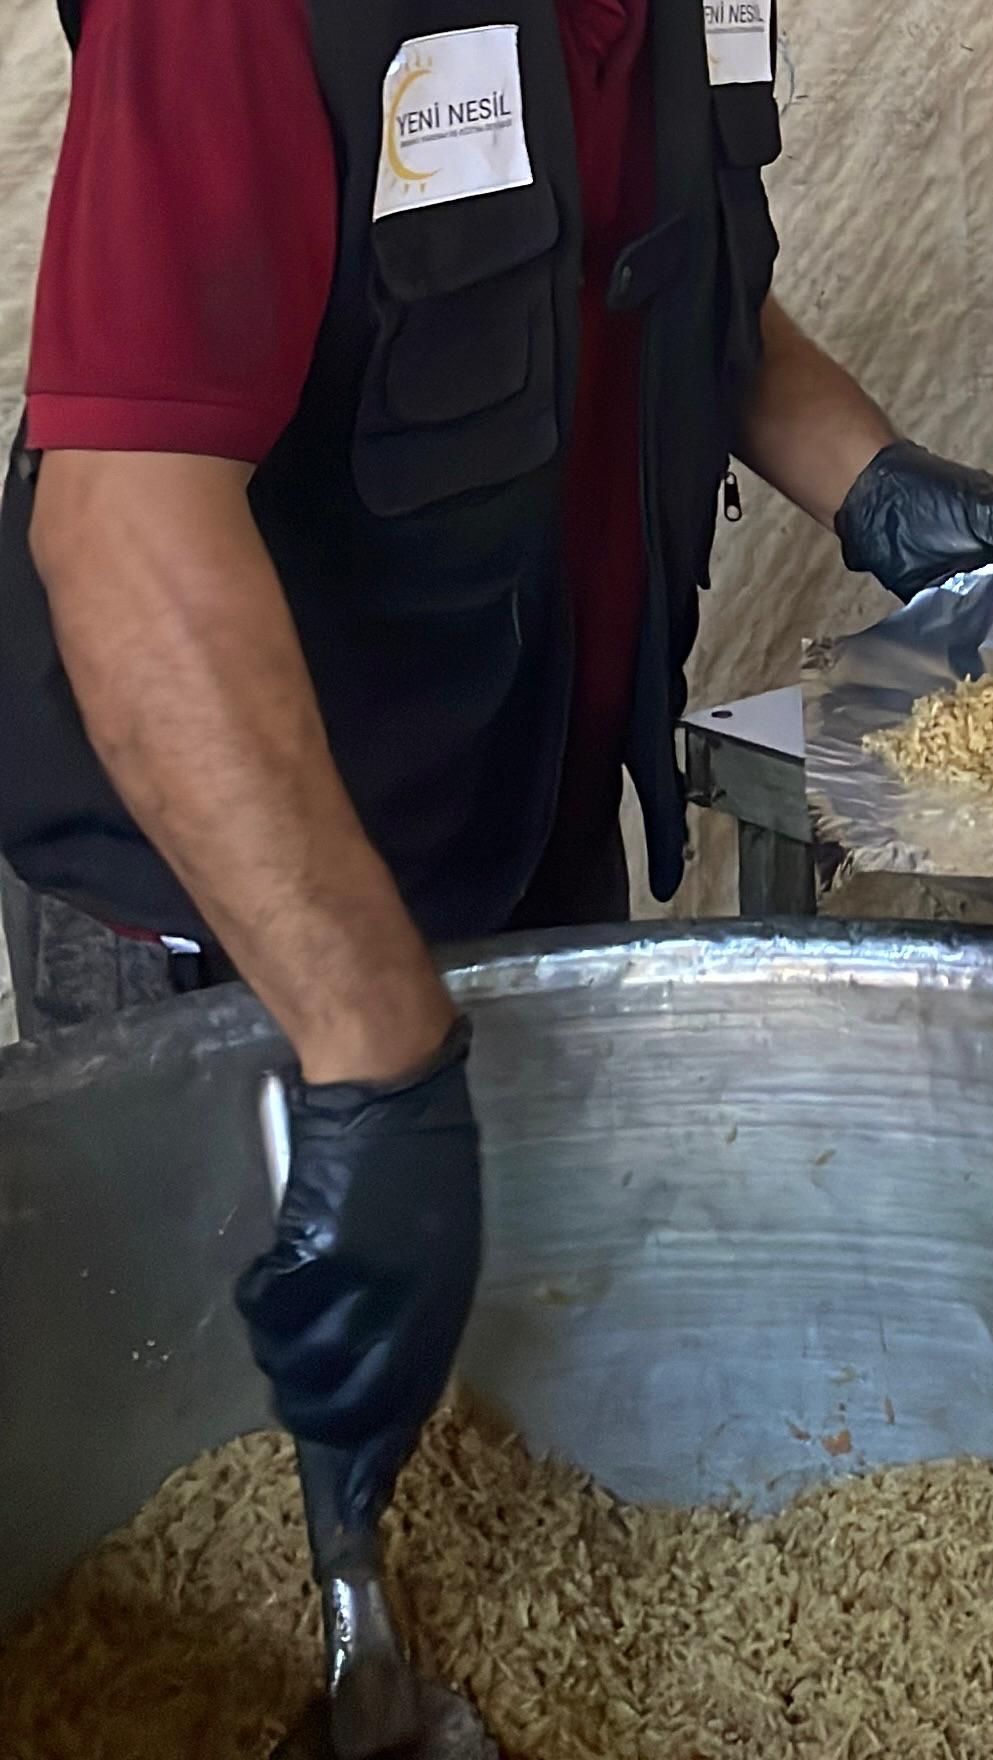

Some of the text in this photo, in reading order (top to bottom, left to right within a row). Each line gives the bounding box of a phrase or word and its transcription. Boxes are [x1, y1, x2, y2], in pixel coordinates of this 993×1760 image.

[703, 0, 724, 24] ENİ
[396, 101, 440, 137] YENİ
[448, 90, 511, 126] NESİL
